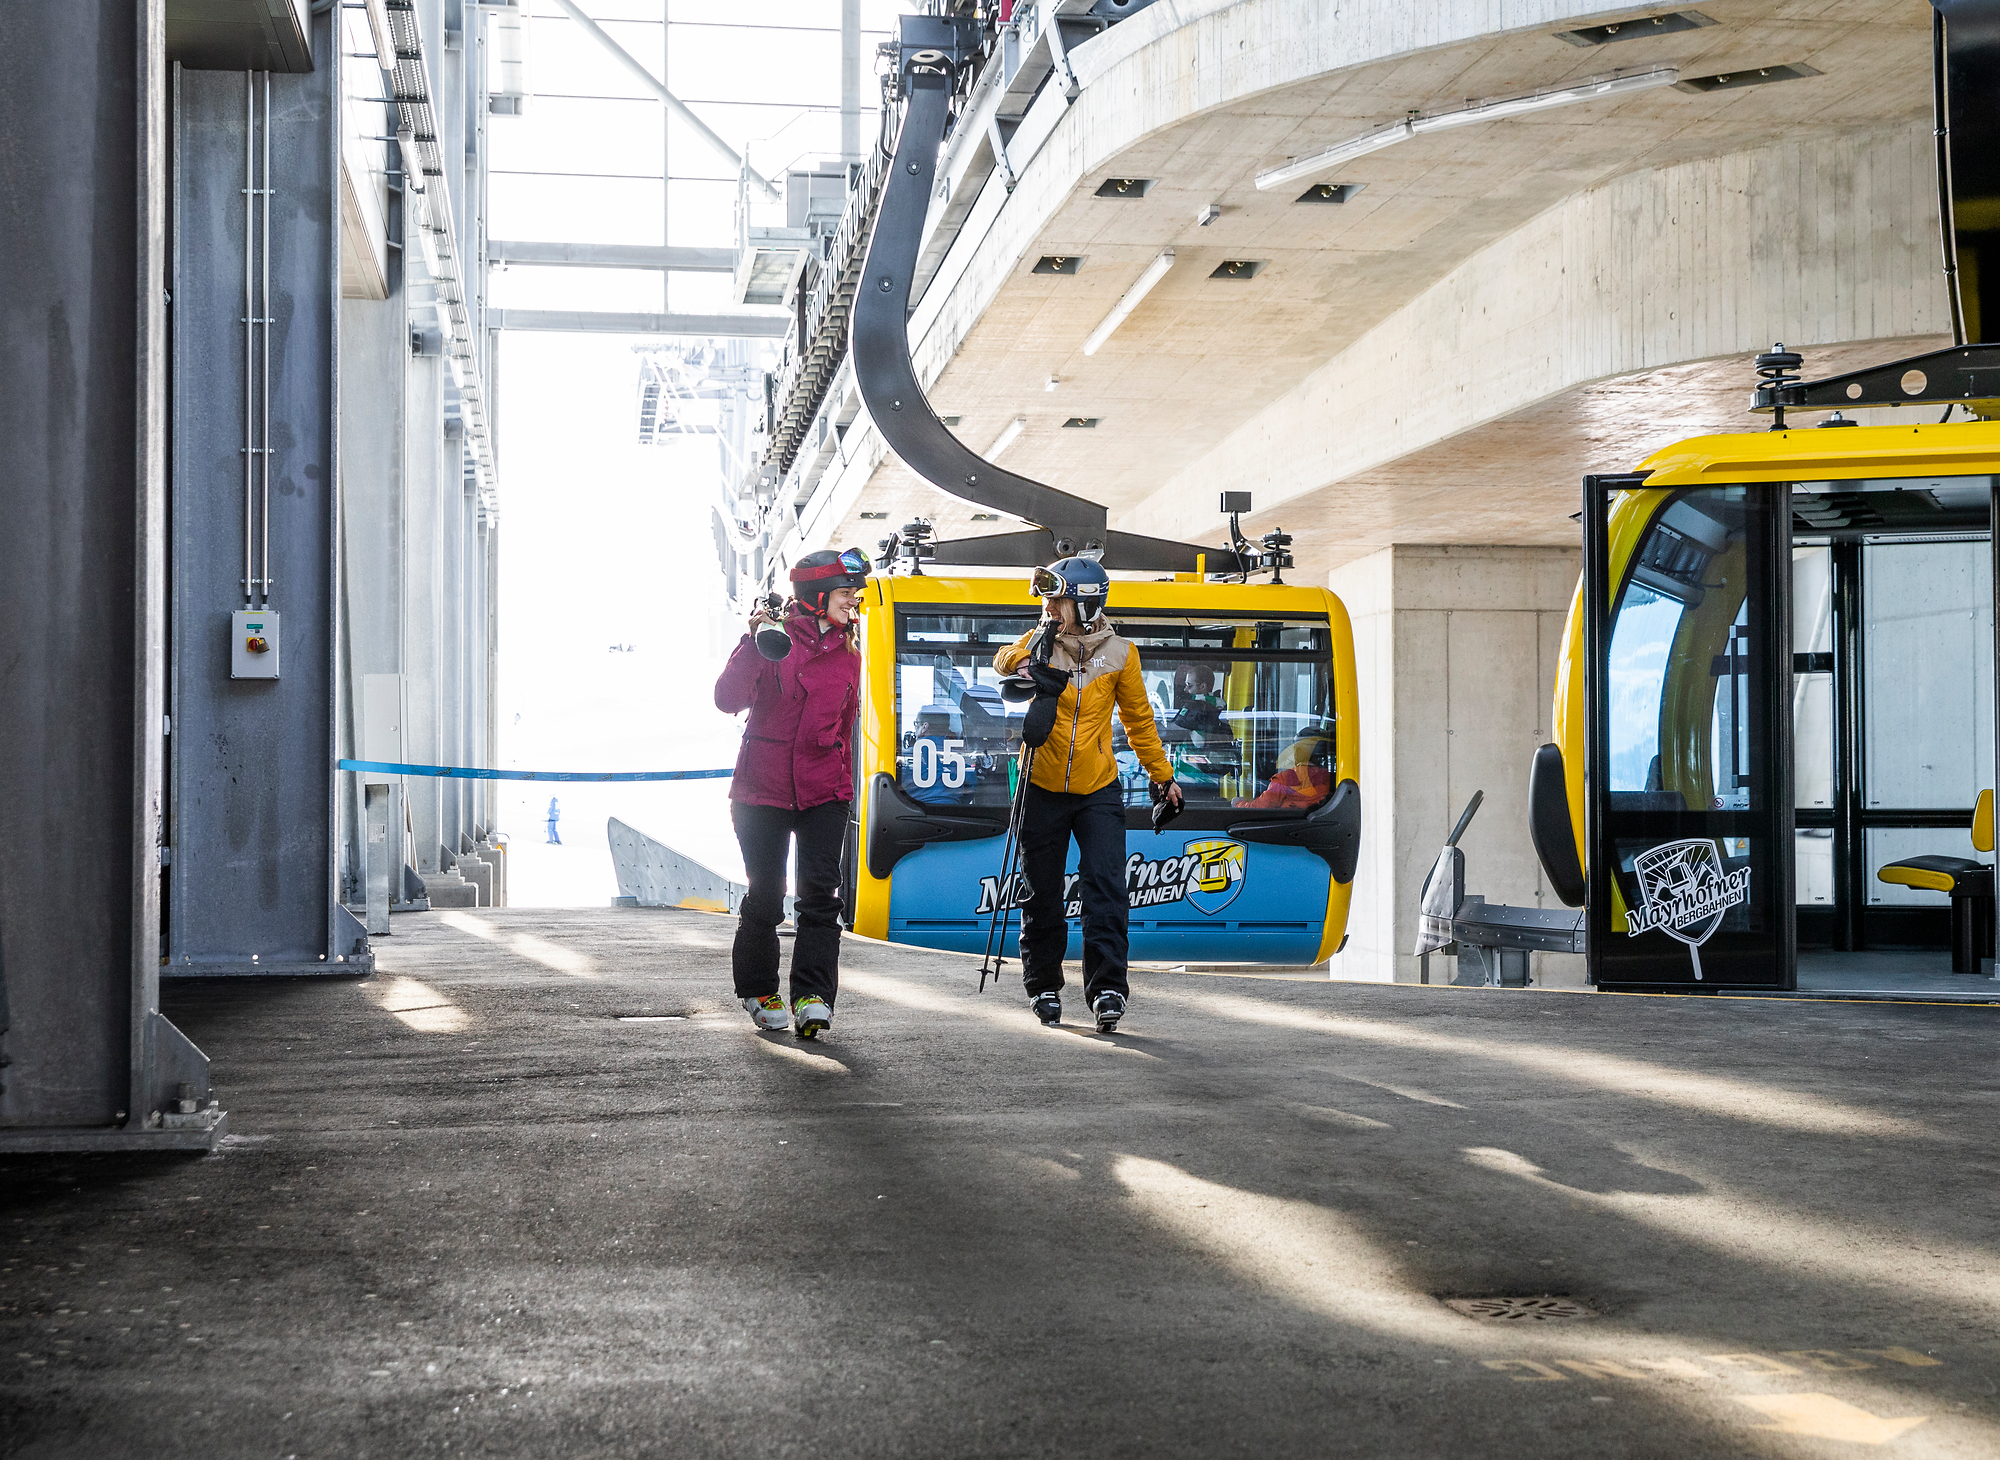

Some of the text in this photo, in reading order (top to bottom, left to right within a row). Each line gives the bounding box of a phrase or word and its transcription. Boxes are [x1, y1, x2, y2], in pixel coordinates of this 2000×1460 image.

[912, 738, 966, 788] 05
[975, 853, 1200, 913] Mrfner
[1065, 883, 1185, 917] BAHNEN
[1626, 867, 1750, 936] Mayrhofner
[1677, 889, 1742, 928] BERGBAHNEN
